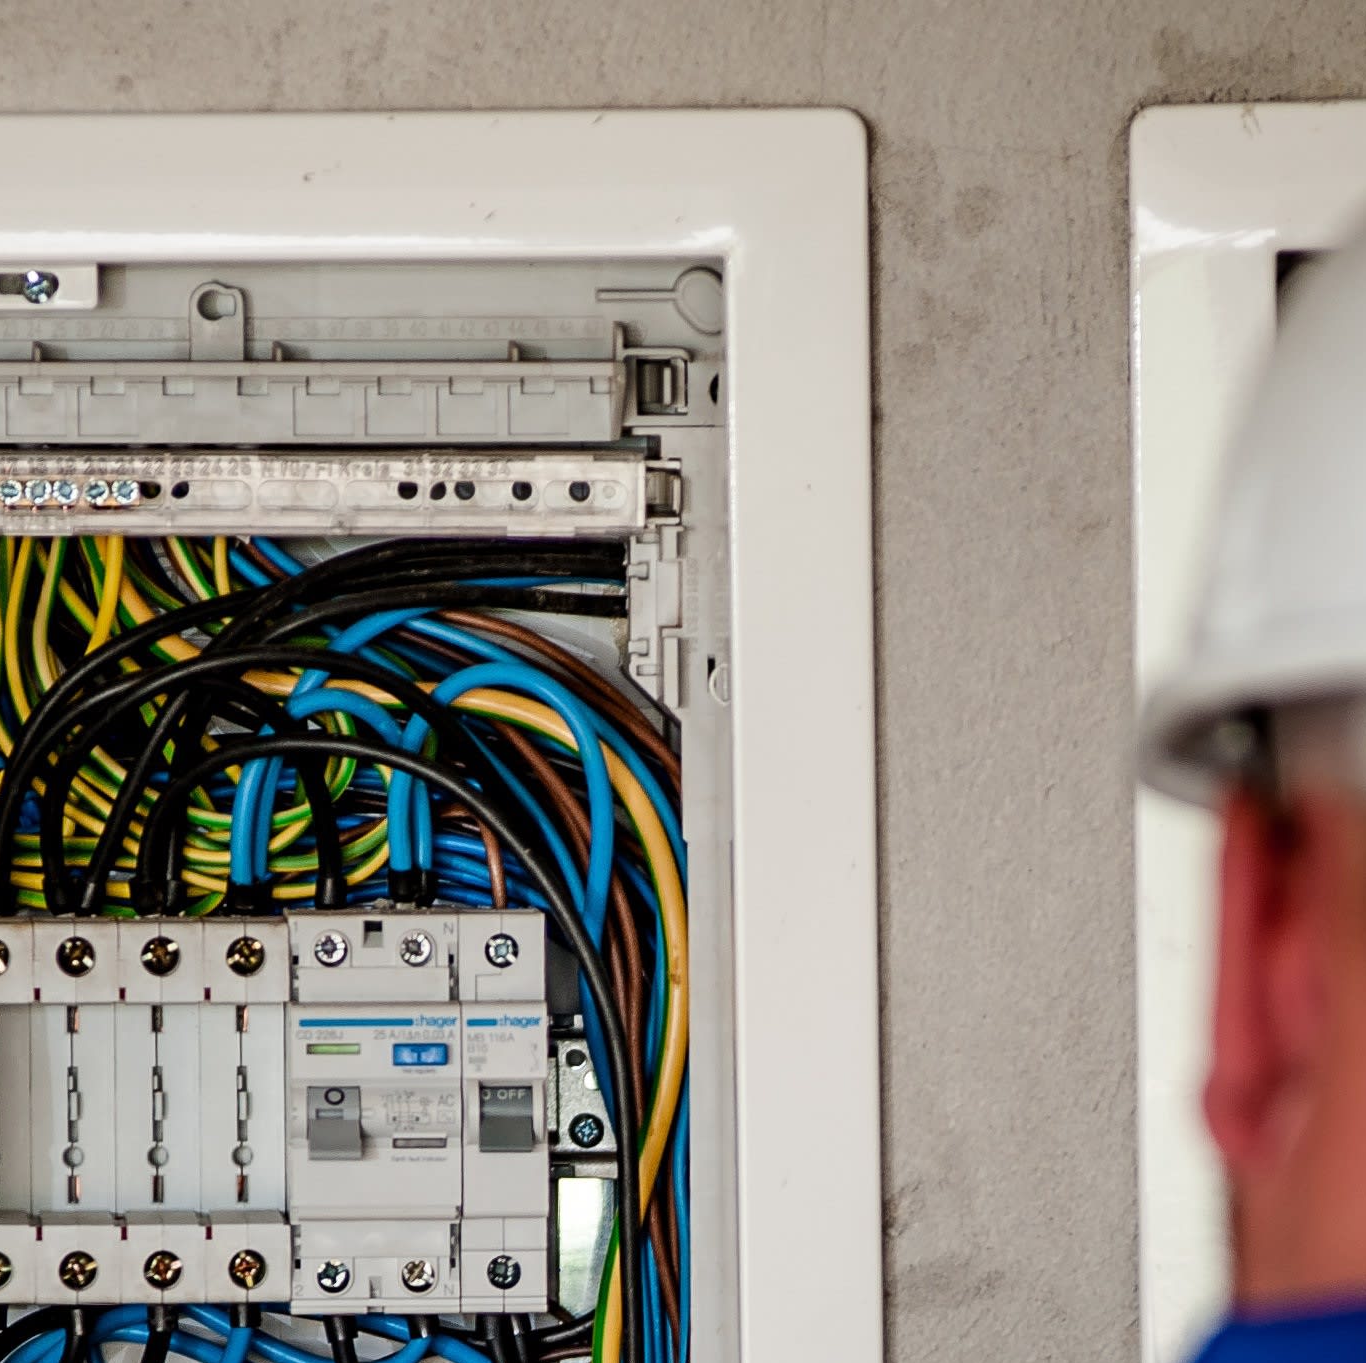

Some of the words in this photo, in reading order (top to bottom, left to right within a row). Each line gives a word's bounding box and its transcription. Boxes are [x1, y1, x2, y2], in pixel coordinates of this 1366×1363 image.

[443, 922, 454, 934] N
[420, 1015, 457, 1028] hager
[504, 1014, 540, 1028] hager
[497, 1089, 525, 1099] OFF
[443, 1283, 454, 1295] N
